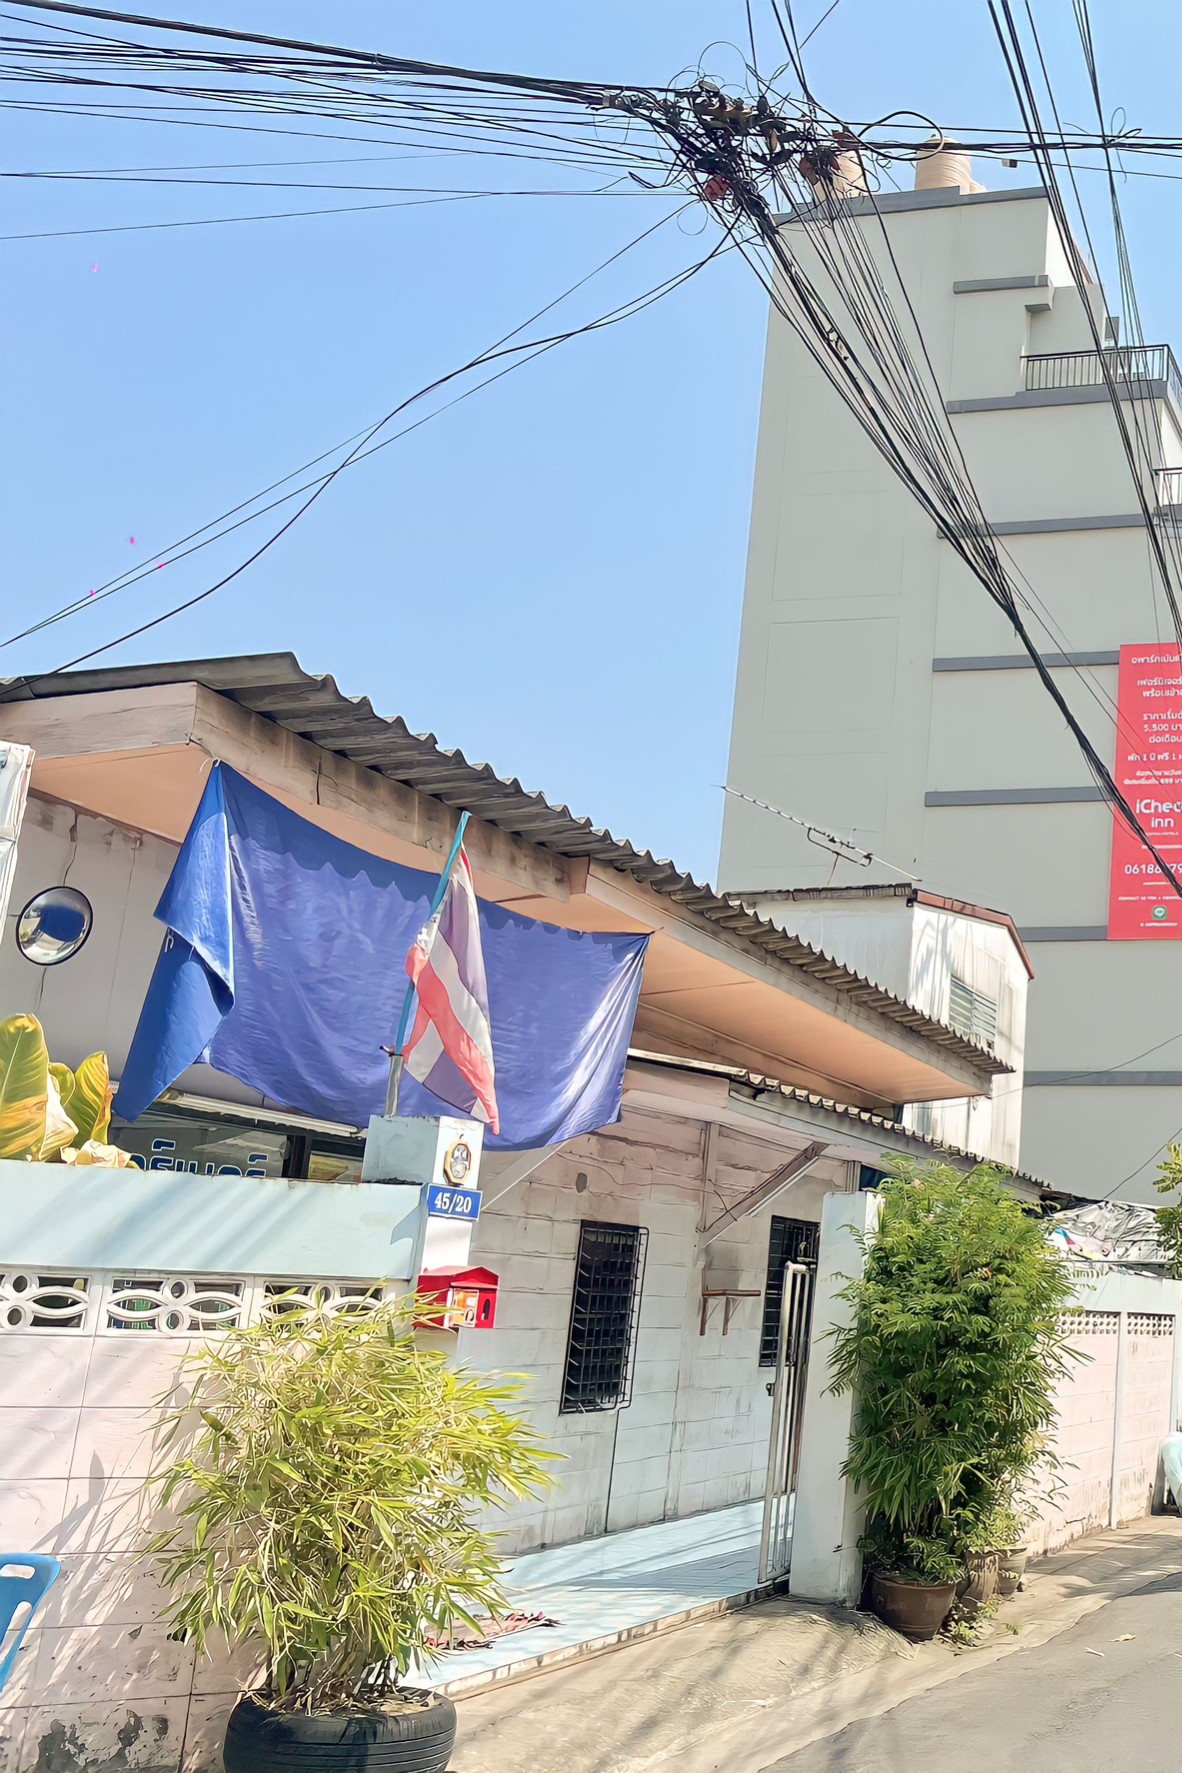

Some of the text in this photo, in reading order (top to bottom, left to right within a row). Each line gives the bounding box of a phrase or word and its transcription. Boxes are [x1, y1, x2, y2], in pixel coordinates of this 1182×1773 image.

[1148, 734, 1182, 743] ต่อเดือน
[1157, 752, 1170, 761] ฟรี
[1151, 817, 1174, 828] inn
[434, 1191, 472, 1214] 45/20
